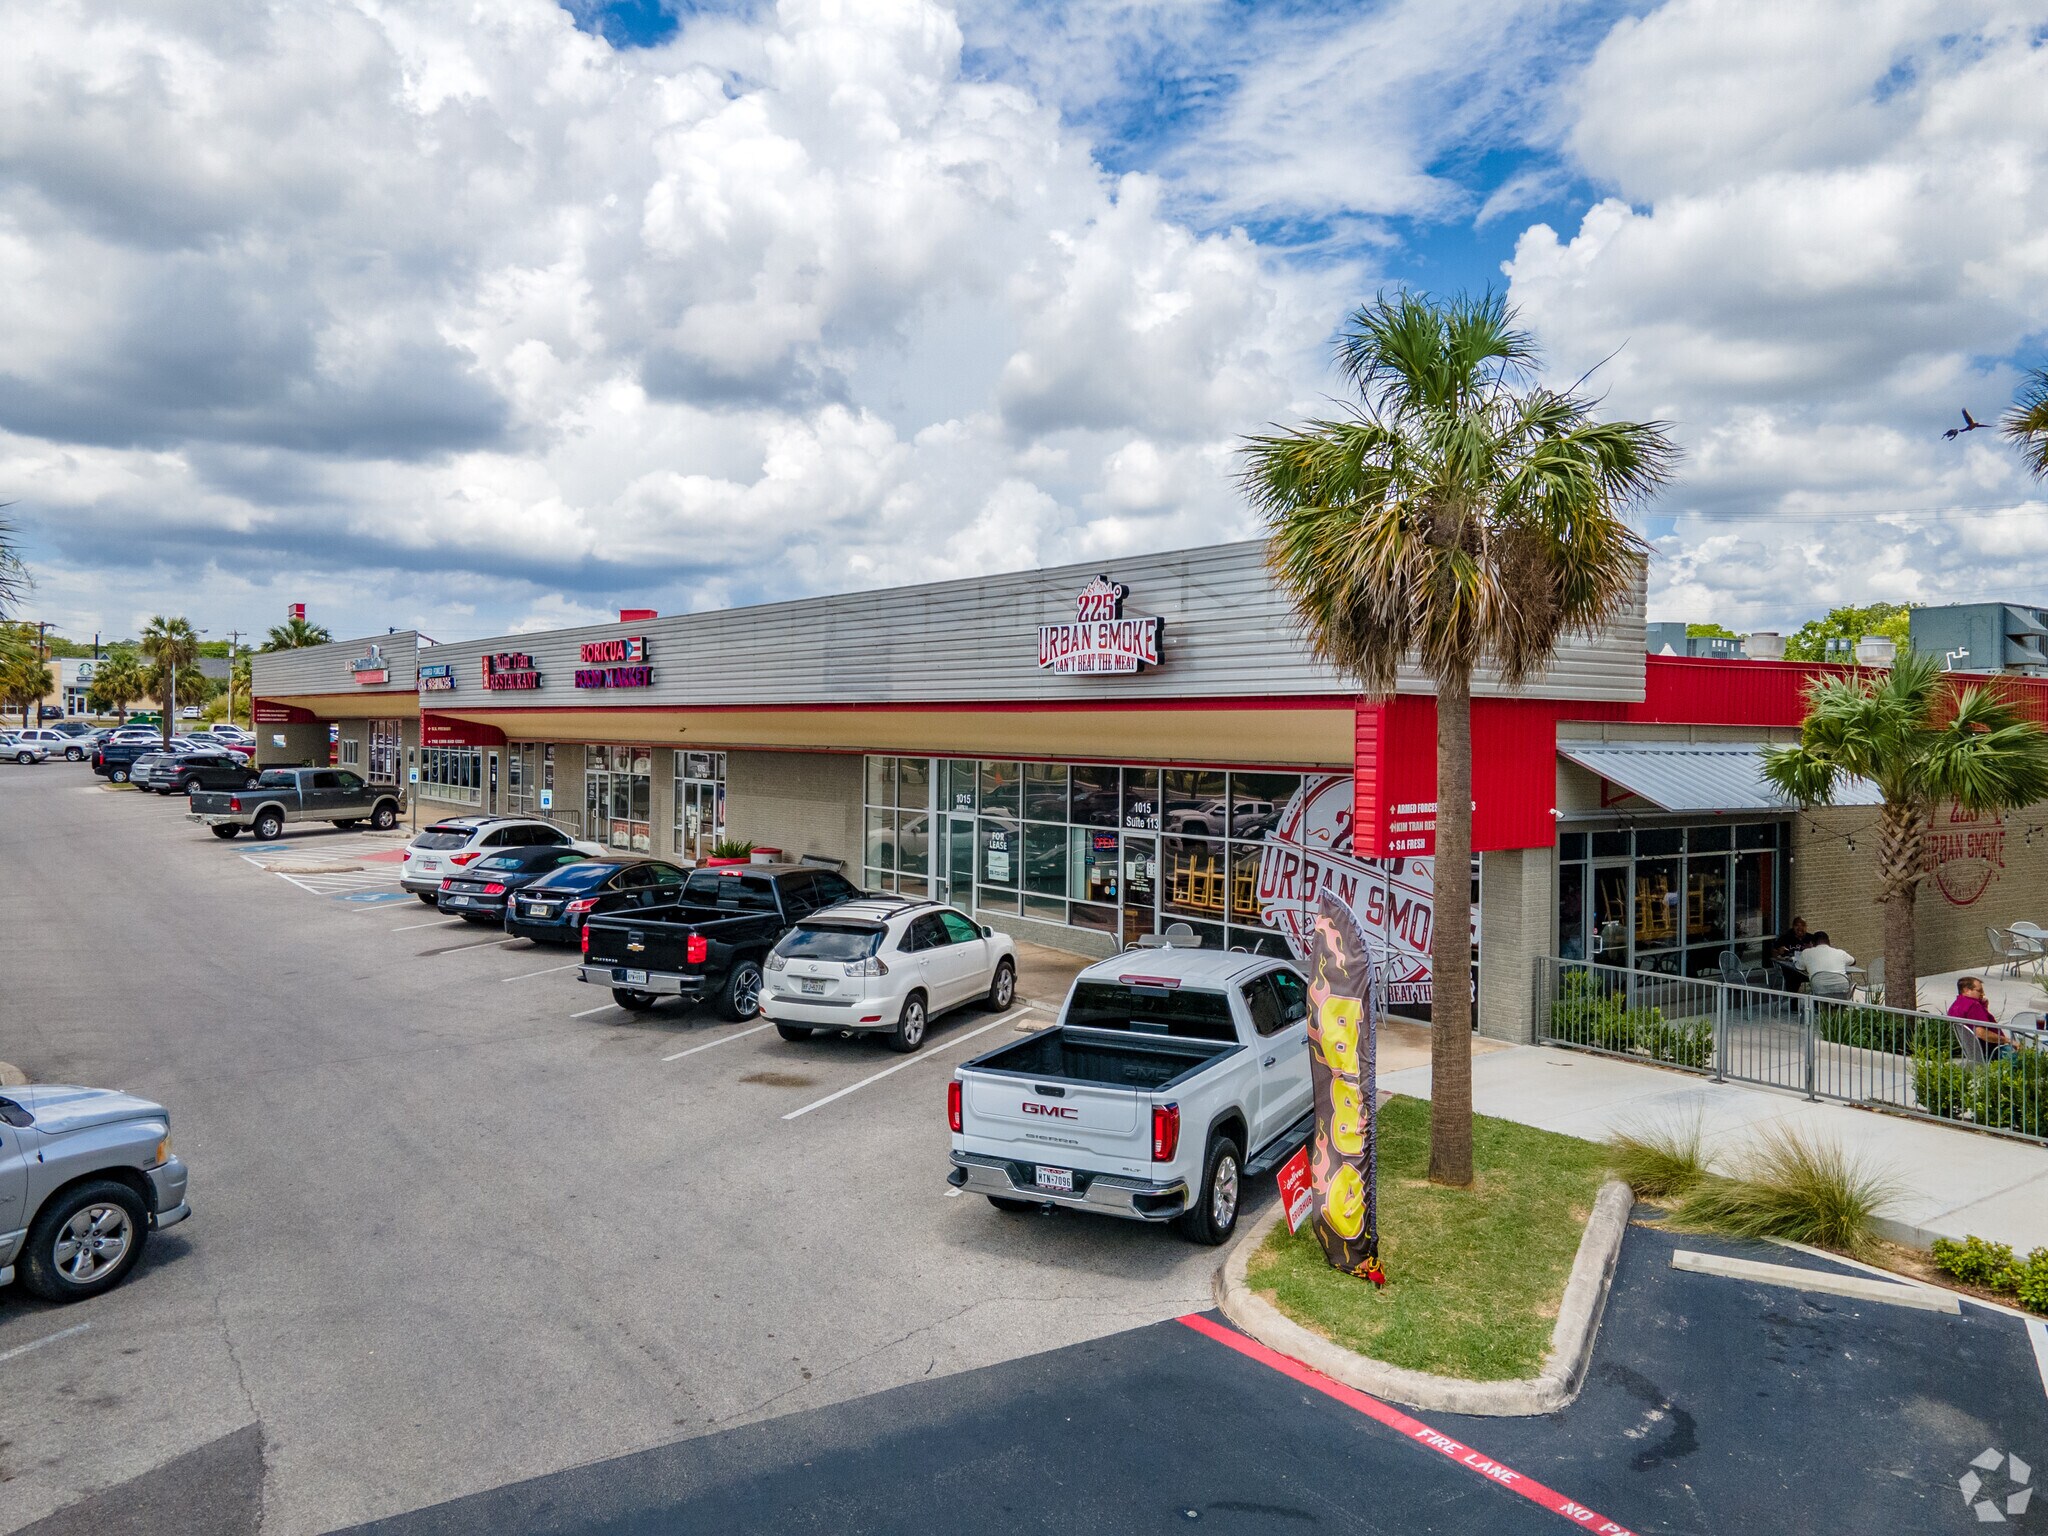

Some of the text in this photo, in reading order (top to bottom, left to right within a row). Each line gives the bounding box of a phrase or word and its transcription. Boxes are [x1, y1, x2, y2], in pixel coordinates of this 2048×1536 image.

[1040, 619, 1156, 665] URBAN SMOKE
[581, 640, 625, 662] BORICUA
[1056, 653, 1136, 672] CAN'T BEAT THE MEAT
[490, 672, 537, 689] RESTAURANT
[604, 667, 650, 688] MARKET
[956, 794, 971, 804] 1015
[1134, 803, 1151, 814] 1015
[1397, 804, 1416, 814] ARMED
[1126, 816, 1158, 829] Suite 113
[1396, 822, 1408, 832] KIM
[992, 832, 1004, 841] FOR
[1094, 837, 1116, 849] OPEN
[989, 841, 1007, 850] LEASE
[1396, 839, 1425, 850] SA FRESH
[1923, 832, 2005, 873] URBAN SMOKE
[1260, 848, 1358, 905] URBAN
[1388, 986, 1414, 1002] BEAT
[1022, 1102, 1079, 1120] GMC
[1025, 1133, 1079, 1145] SIERRA
[1415, 1429, 1463, 1454] FIRE
[1464, 1454, 1520, 1484] LANE
[1559, 1502, 1595, 1521] NO
